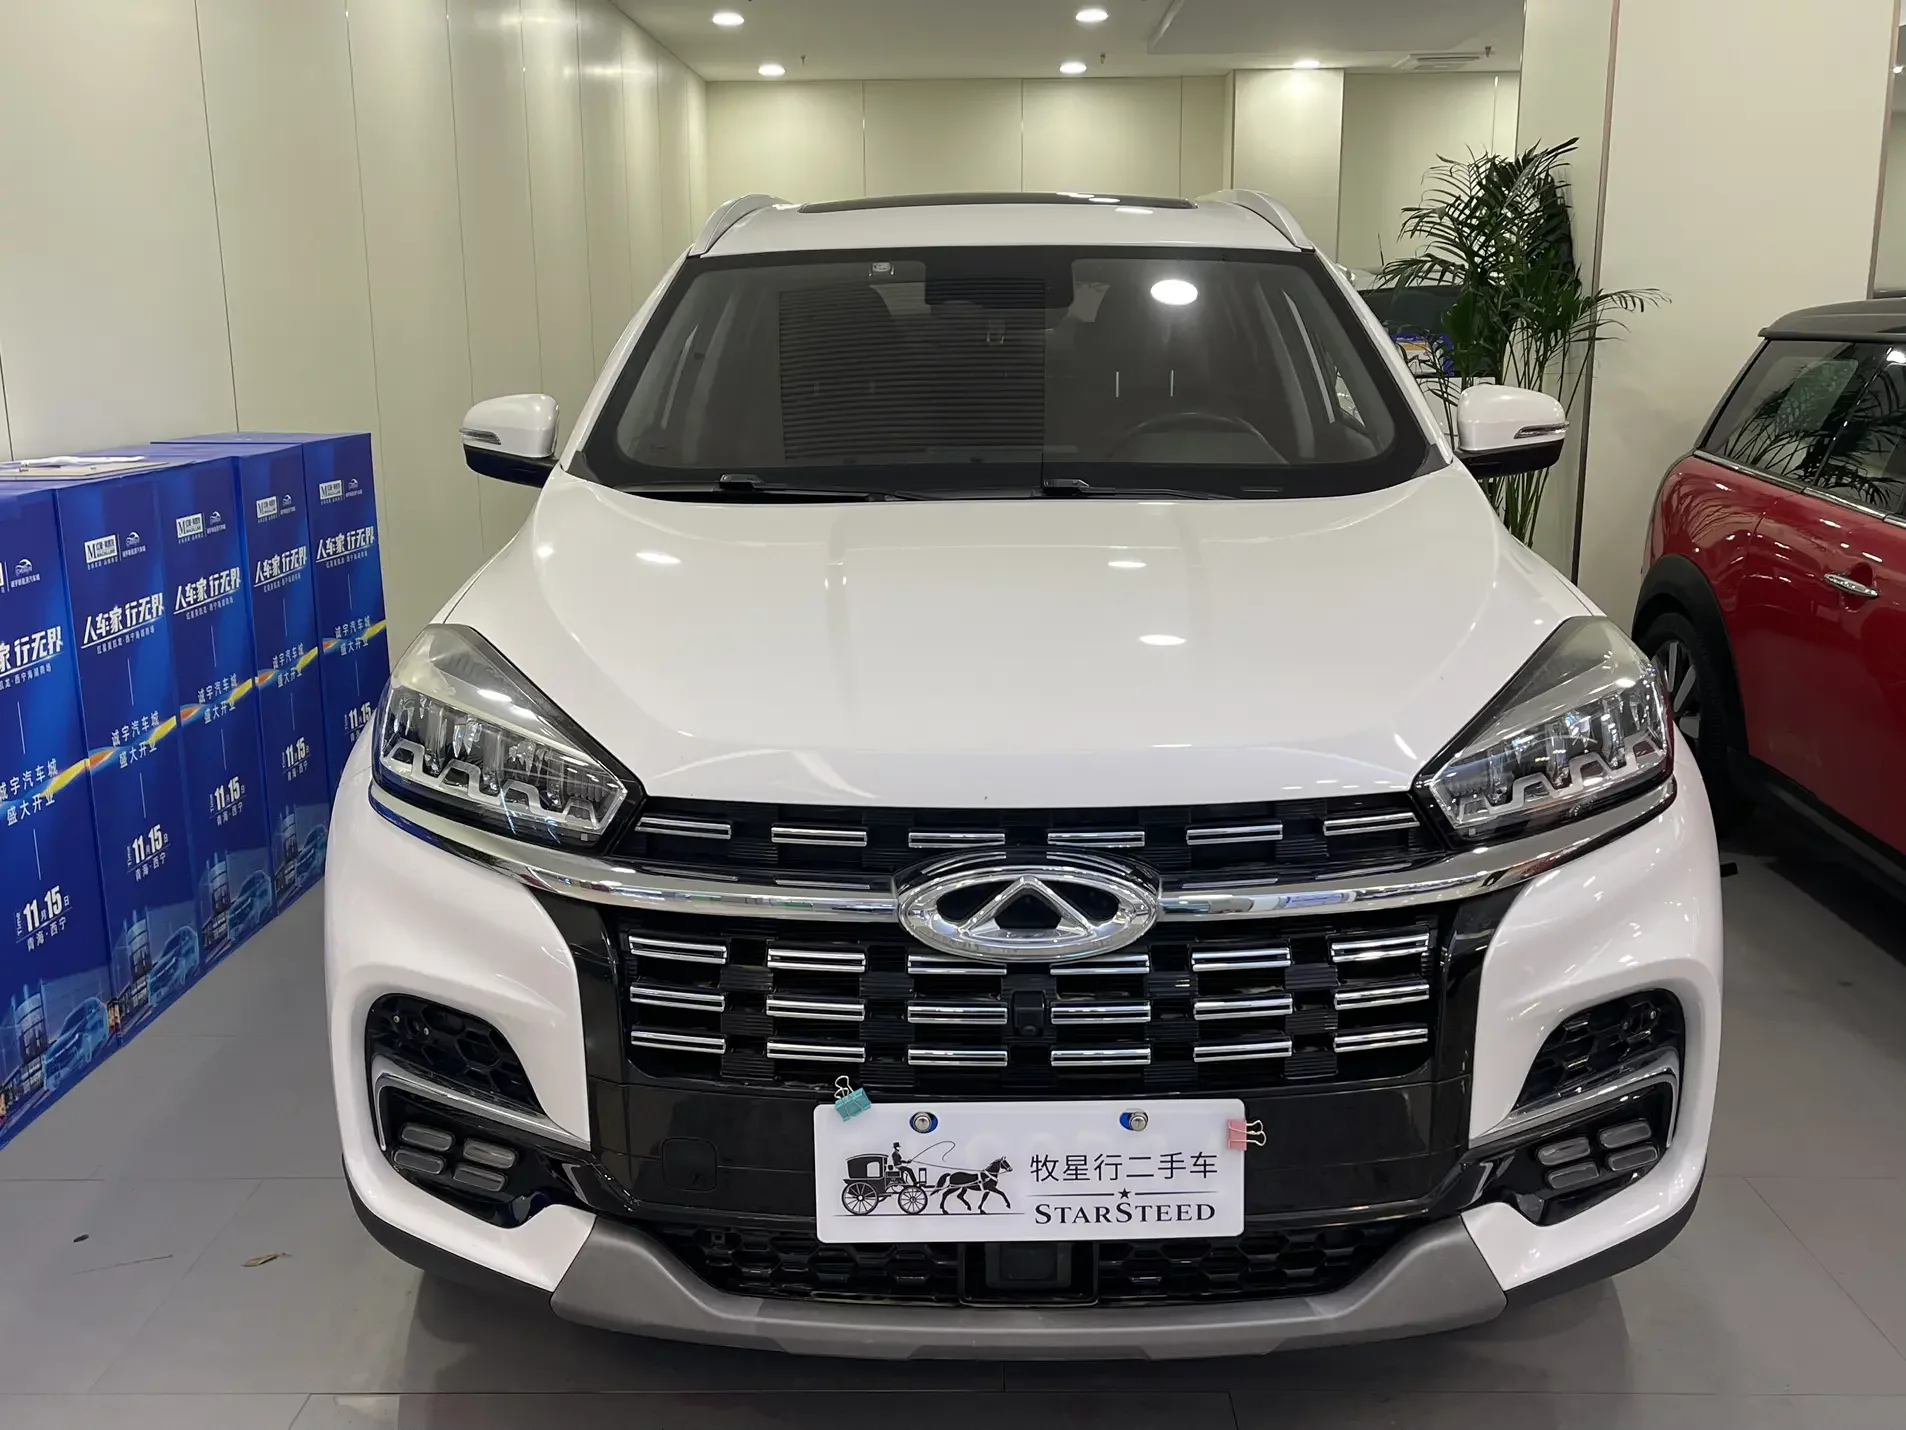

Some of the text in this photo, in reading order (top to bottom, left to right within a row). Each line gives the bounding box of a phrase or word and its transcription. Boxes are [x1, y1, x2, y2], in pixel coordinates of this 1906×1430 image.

[7, 788, 56, 827] 盛大开业
[1029, 1152, 1218, 1184] 牧星行二手车
